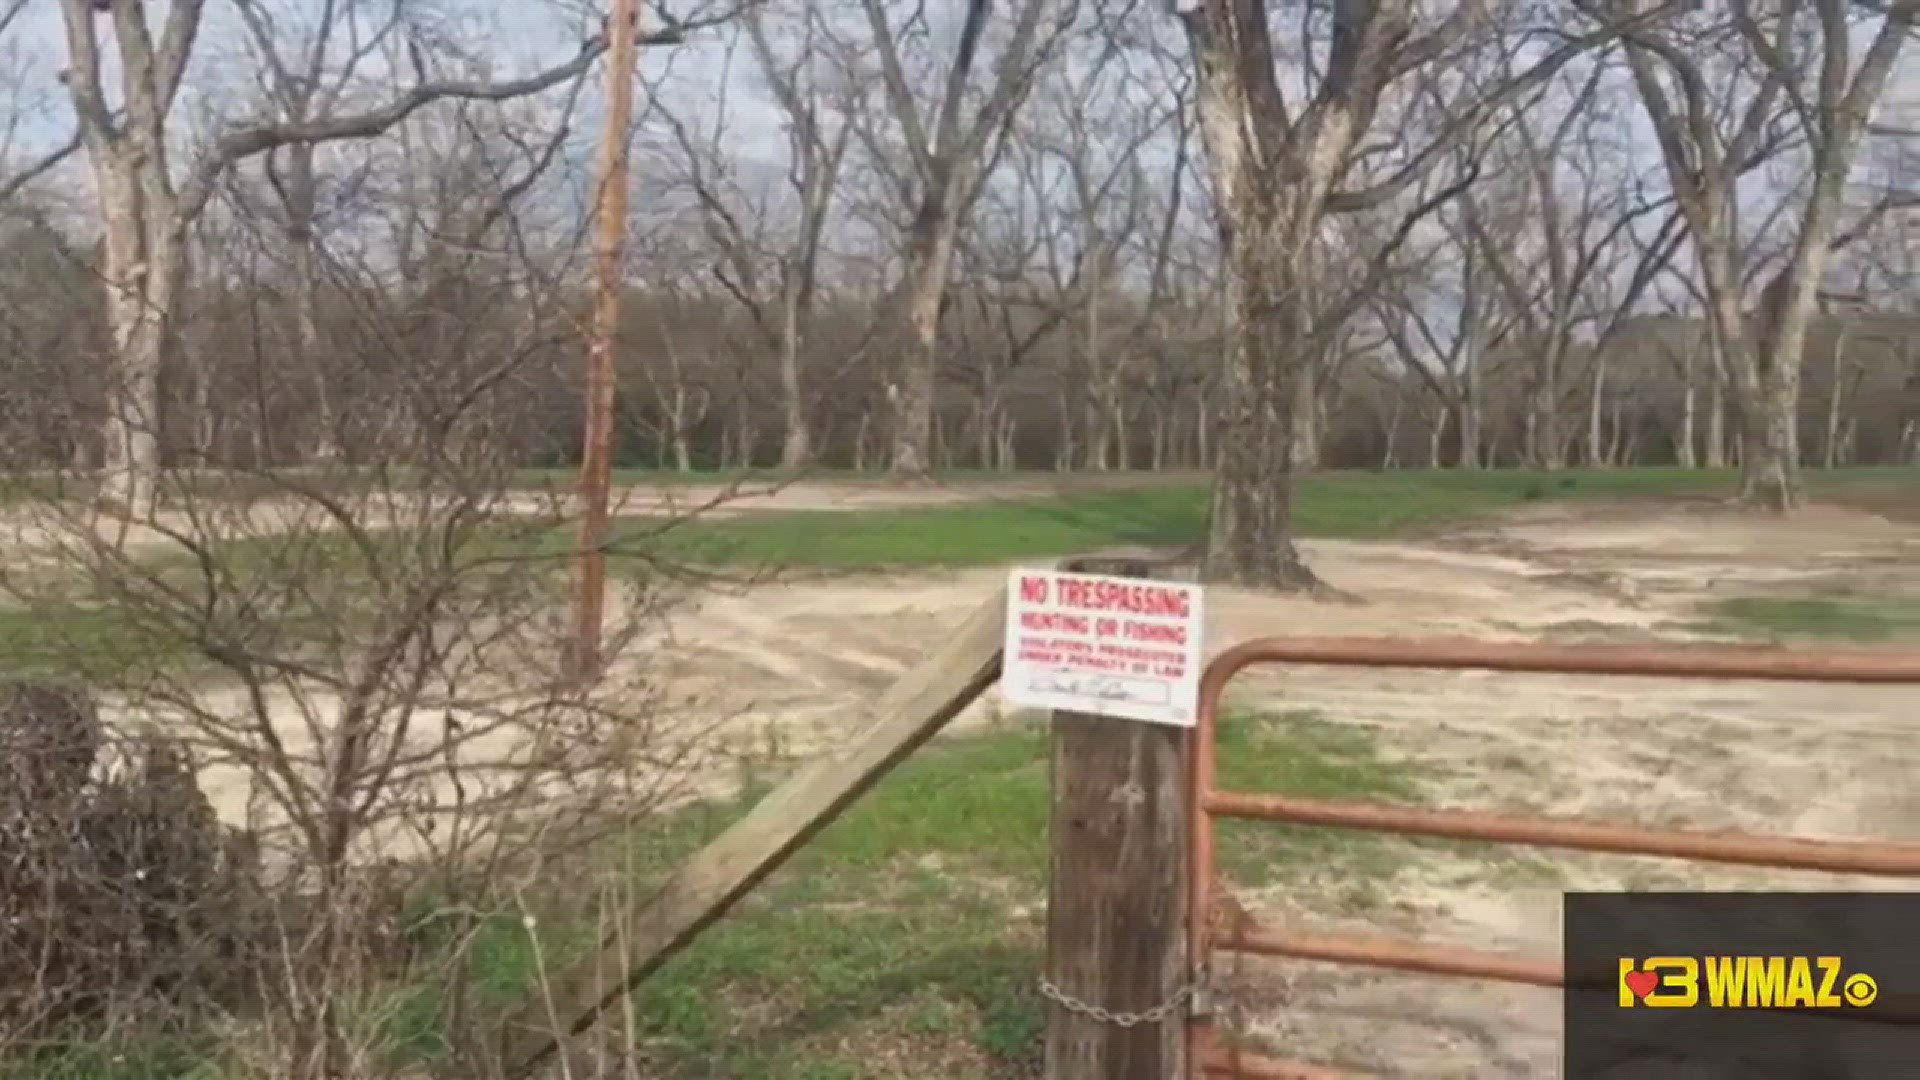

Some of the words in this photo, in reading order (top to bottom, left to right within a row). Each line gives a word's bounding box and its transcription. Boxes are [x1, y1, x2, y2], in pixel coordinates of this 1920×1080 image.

[1020, 576, 1048, 604] NO
[1056, 577, 1190, 618] TRESPASSING
[1020, 611, 1088, 635] HUNTING
[1096, 617, 1118, 637] OR
[1123, 620, 1187, 645] FISHING
[1154, 664, 1184, 678] LAW
